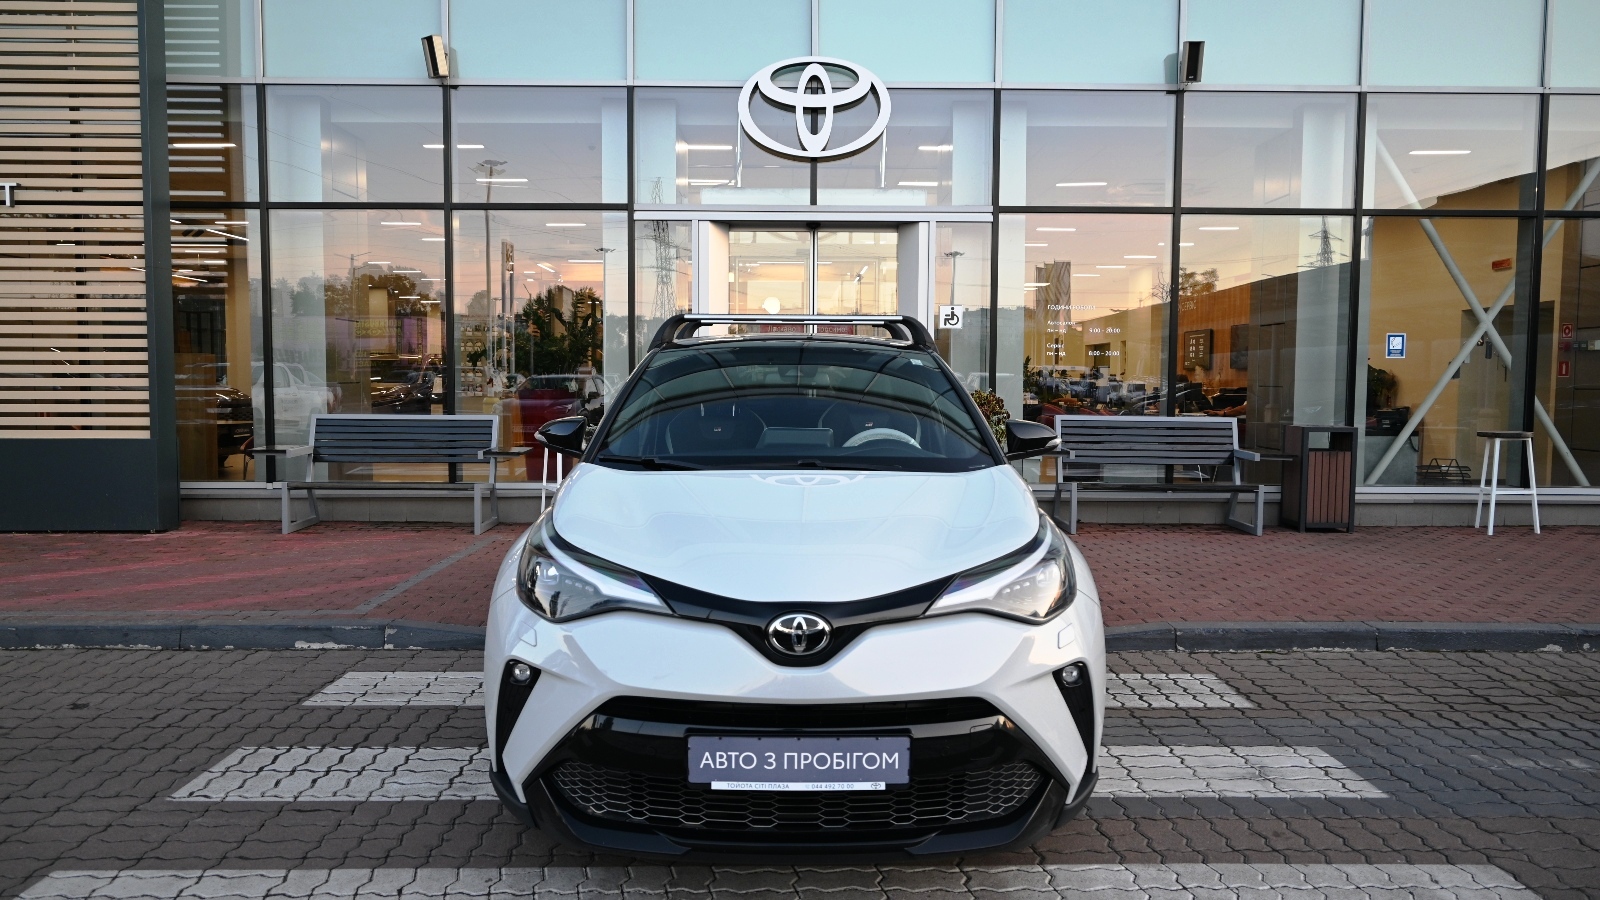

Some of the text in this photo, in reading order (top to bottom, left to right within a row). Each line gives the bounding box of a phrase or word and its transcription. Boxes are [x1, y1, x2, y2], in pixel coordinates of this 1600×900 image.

[699, 751, 899, 770] АВТО З ПРОБІГОМ
